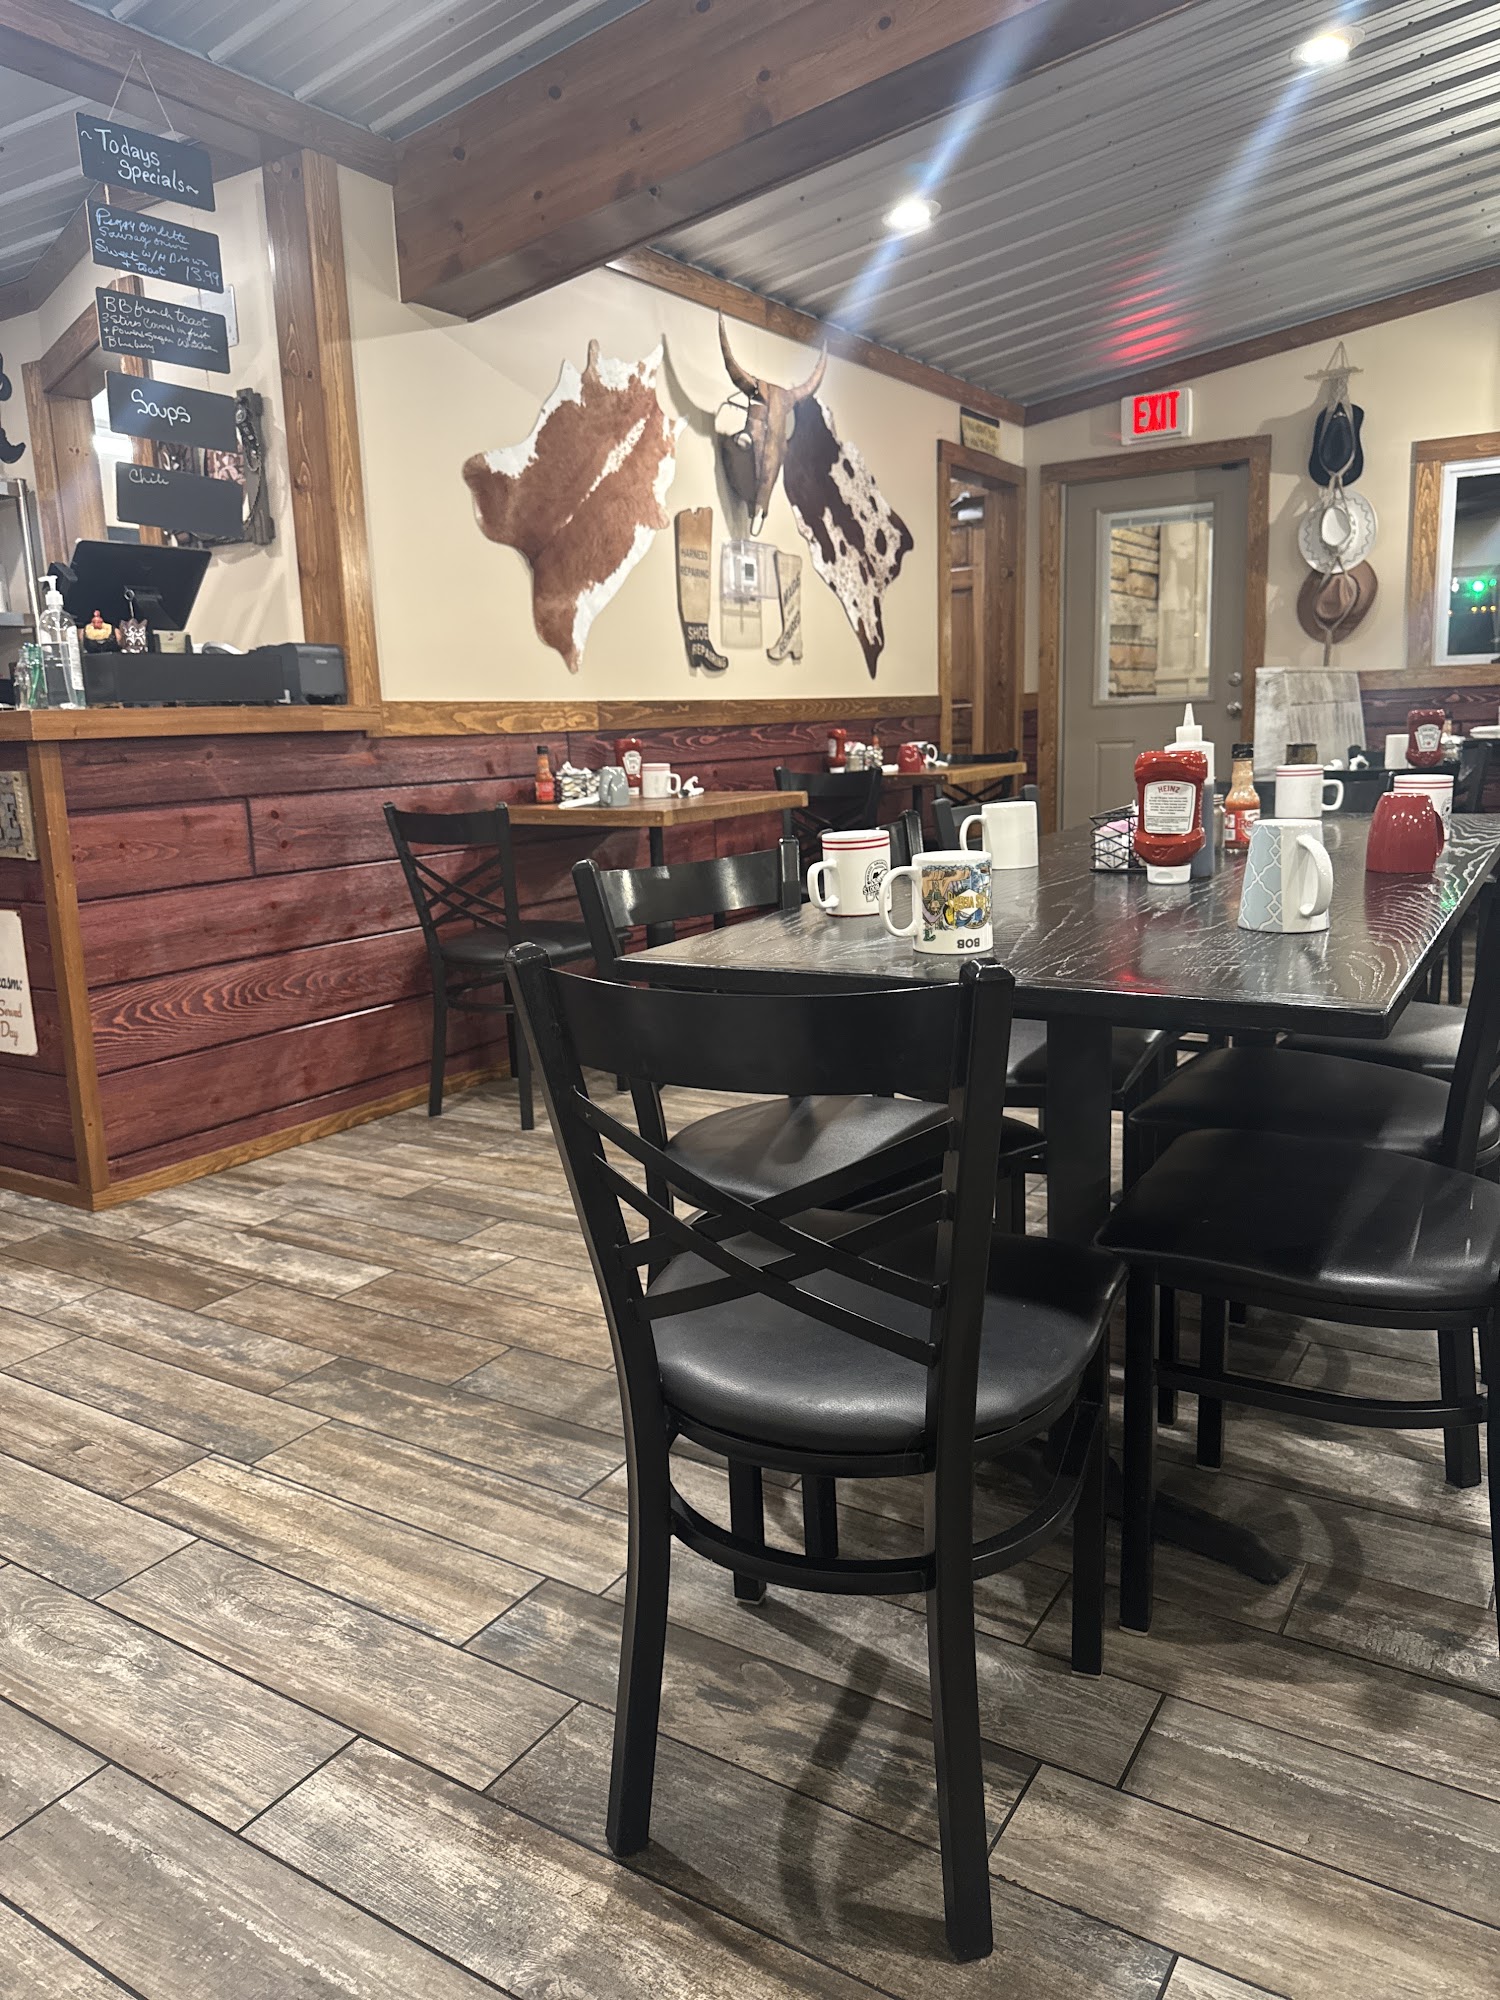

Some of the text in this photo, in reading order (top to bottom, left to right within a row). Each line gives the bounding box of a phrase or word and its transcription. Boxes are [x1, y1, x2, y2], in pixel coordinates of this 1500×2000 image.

[186, 265, 220, 287] 13.99
[174, 308, 211, 328] toast
[131, 388, 191, 426] Soups
[1133, 390, 1180, 435] EXIT
[681, 548, 708, 560] HARNESS
[680, 566, 709, 580] REPAIRING
[688, 626, 709, 641] SHOE
[1157, 785, 1181, 794] HEINZ
[957, 937, 980, 949] BOB
[0, 1020, 19, 1047] Day
